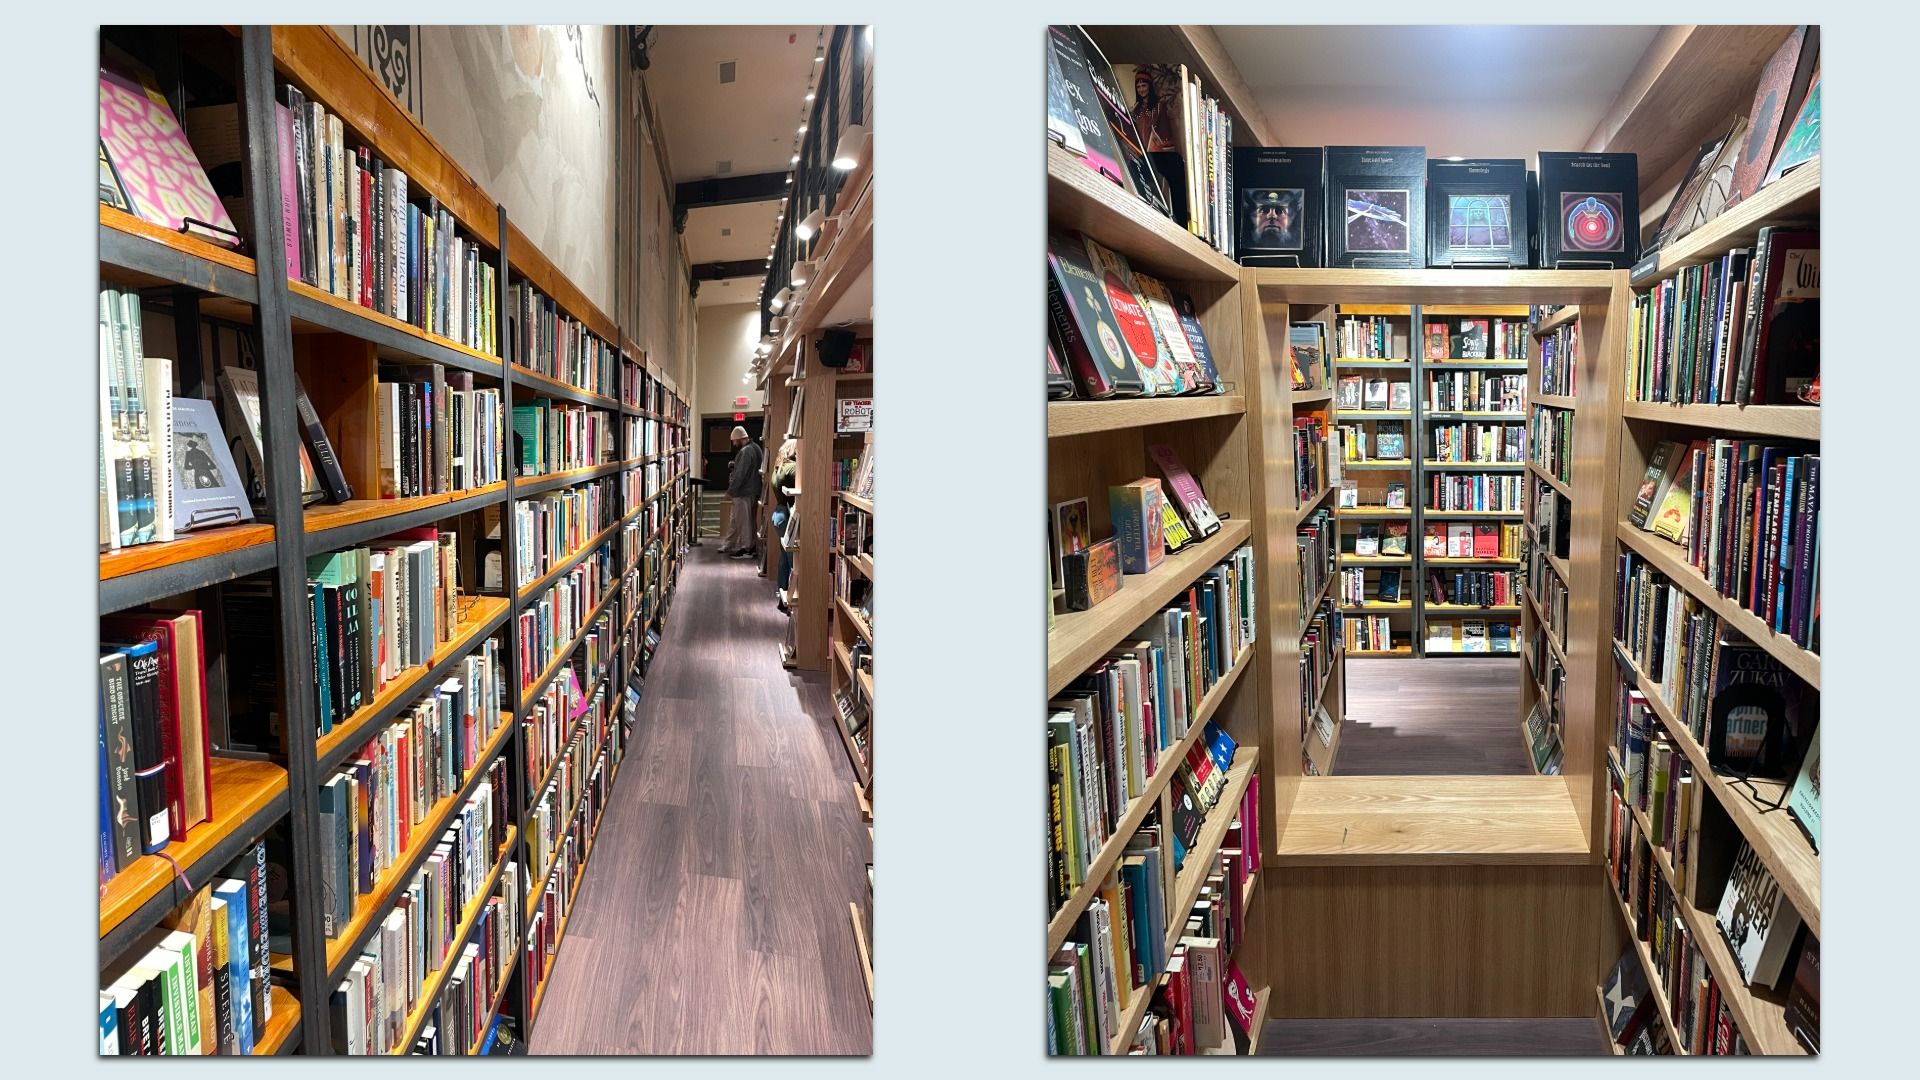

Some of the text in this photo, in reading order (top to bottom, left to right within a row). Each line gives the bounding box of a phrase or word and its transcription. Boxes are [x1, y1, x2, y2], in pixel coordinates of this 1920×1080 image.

[397, 178, 407, 223] Purity
[399, 231, 407, 294] Franzen
[116, 348, 126, 386] Didion
[135, 350, 145, 388] Didion
[844, 407, 872, 416] ROBOT
[124, 457, 133, 483] John
[142, 457, 151, 481] John
[313, 439, 333, 465] JULIP
[1770, 487, 1781, 541] TEMPLARS
[1799, 481, 1807, 514] HYPNOTISM
[1805, 484, 1816, 522] MAYAN
[1802, 524, 1812, 570] PROPHECIES
[1703, 615, 1715, 679] SPIRITWALKER
[108, 678, 118, 725] BIRD OF NIGHT
[116, 691, 125, 721] OBSCENE
[122, 767, 130, 782] José
[1051, 784, 1063, 823] SPARE
[1054, 825, 1064, 852] RIBS
[250, 867, 258, 884] THE
[252, 886, 260, 919] MIGHTY
[1729, 865, 1769, 941] AVENGER
[204, 920, 212, 961] MEMOIRS
[171, 974, 183, 1030] INVISIBLE
[184, 953, 198, 1036] INVISIBLE MAN
[220, 972, 233, 1045] SILENCE
[127, 1005, 138, 1046] ELLIS
[141, 1016, 151, 1049] BRET
[157, 1006, 166, 1040] BRET
